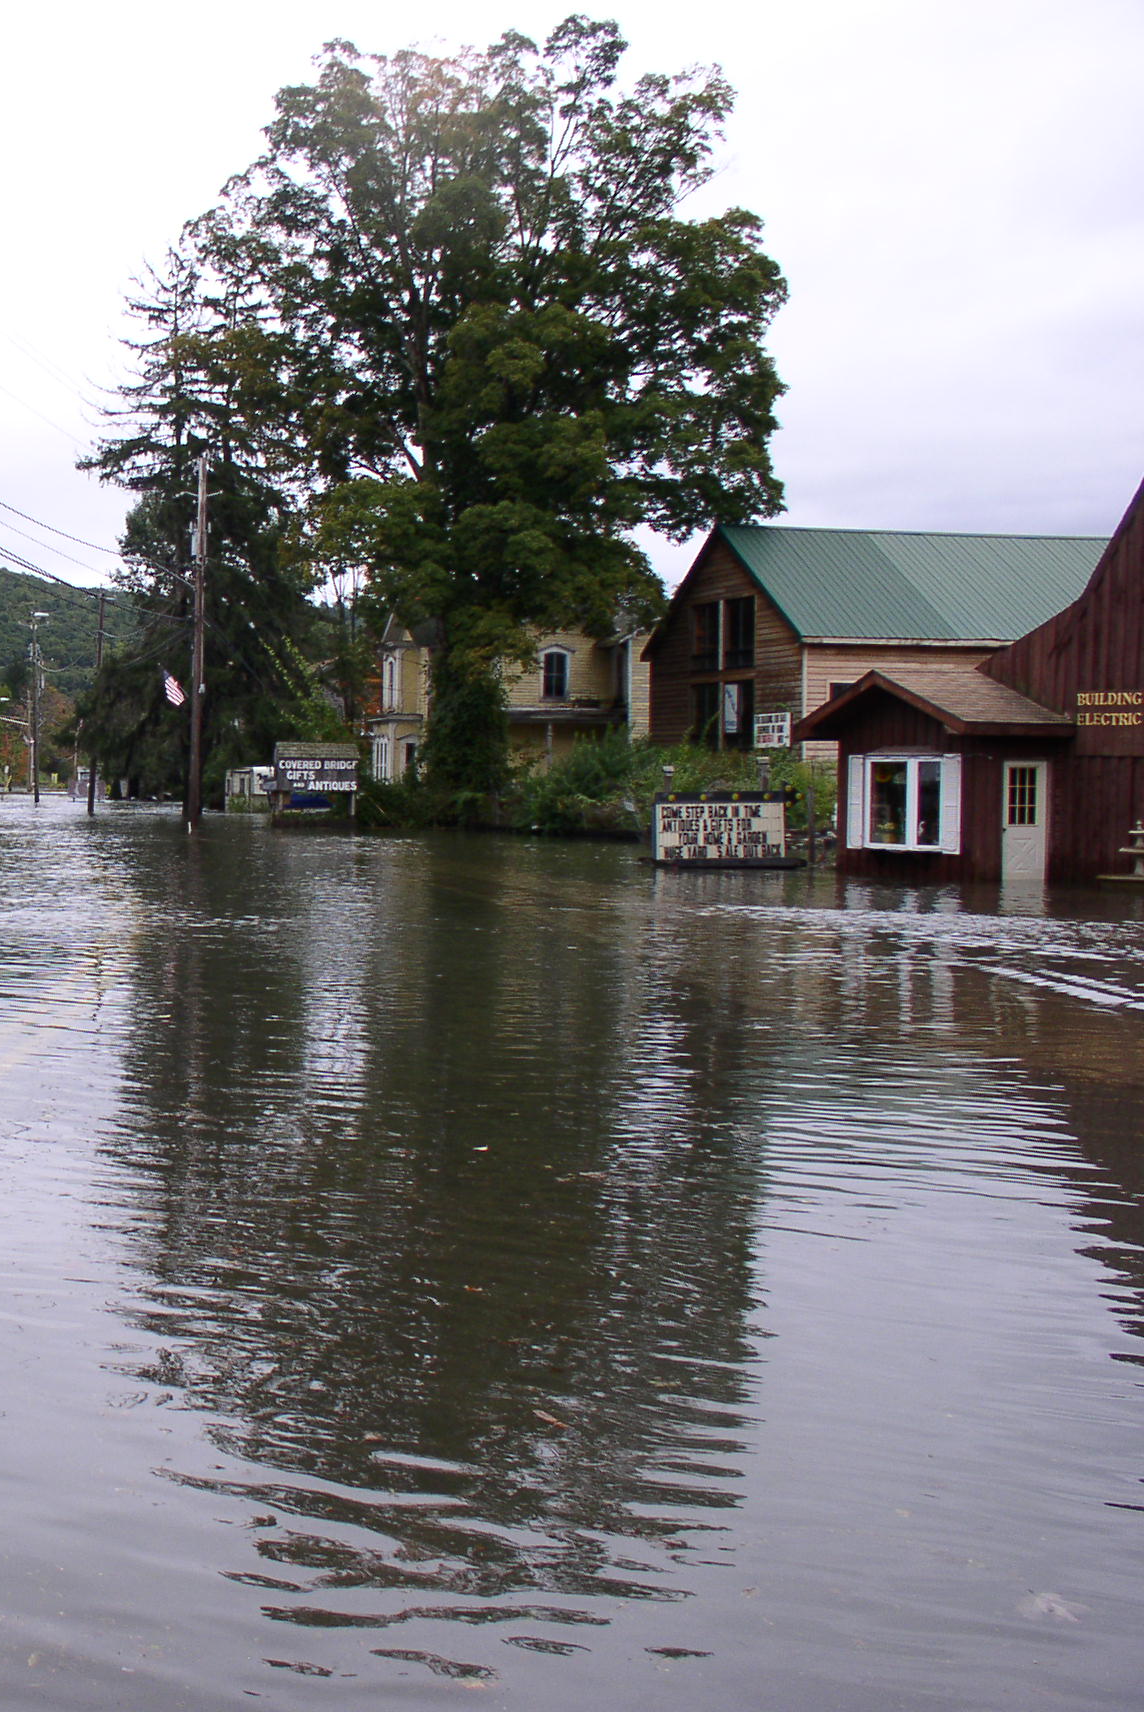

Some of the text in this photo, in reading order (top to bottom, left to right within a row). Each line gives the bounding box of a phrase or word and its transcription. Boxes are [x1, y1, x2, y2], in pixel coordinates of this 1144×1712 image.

[1077, 692, 1142, 706] BUILDING
[1077, 712, 1142, 726] ELECTRIC
[279, 760, 322, 769] COVERED
[286, 771, 315, 780] GIFTS
[307, 781, 358, 791] ANTIQUES
[661, 805, 761, 819] COME STEP BACK IN TIME
[662, 819, 700, 832] ANTIQUES
[710, 818, 733, 831] GIFTS
[736, 818, 752, 831] FOR
[678, 832, 698, 845] YOUR
[703, 832, 723, 845] HOME
[736, 831, 767, 844] GARDEN
[687, 845, 708, 858] YARD
[742, 844, 758, 857] OUT
[761, 844, 781, 857] BACK
